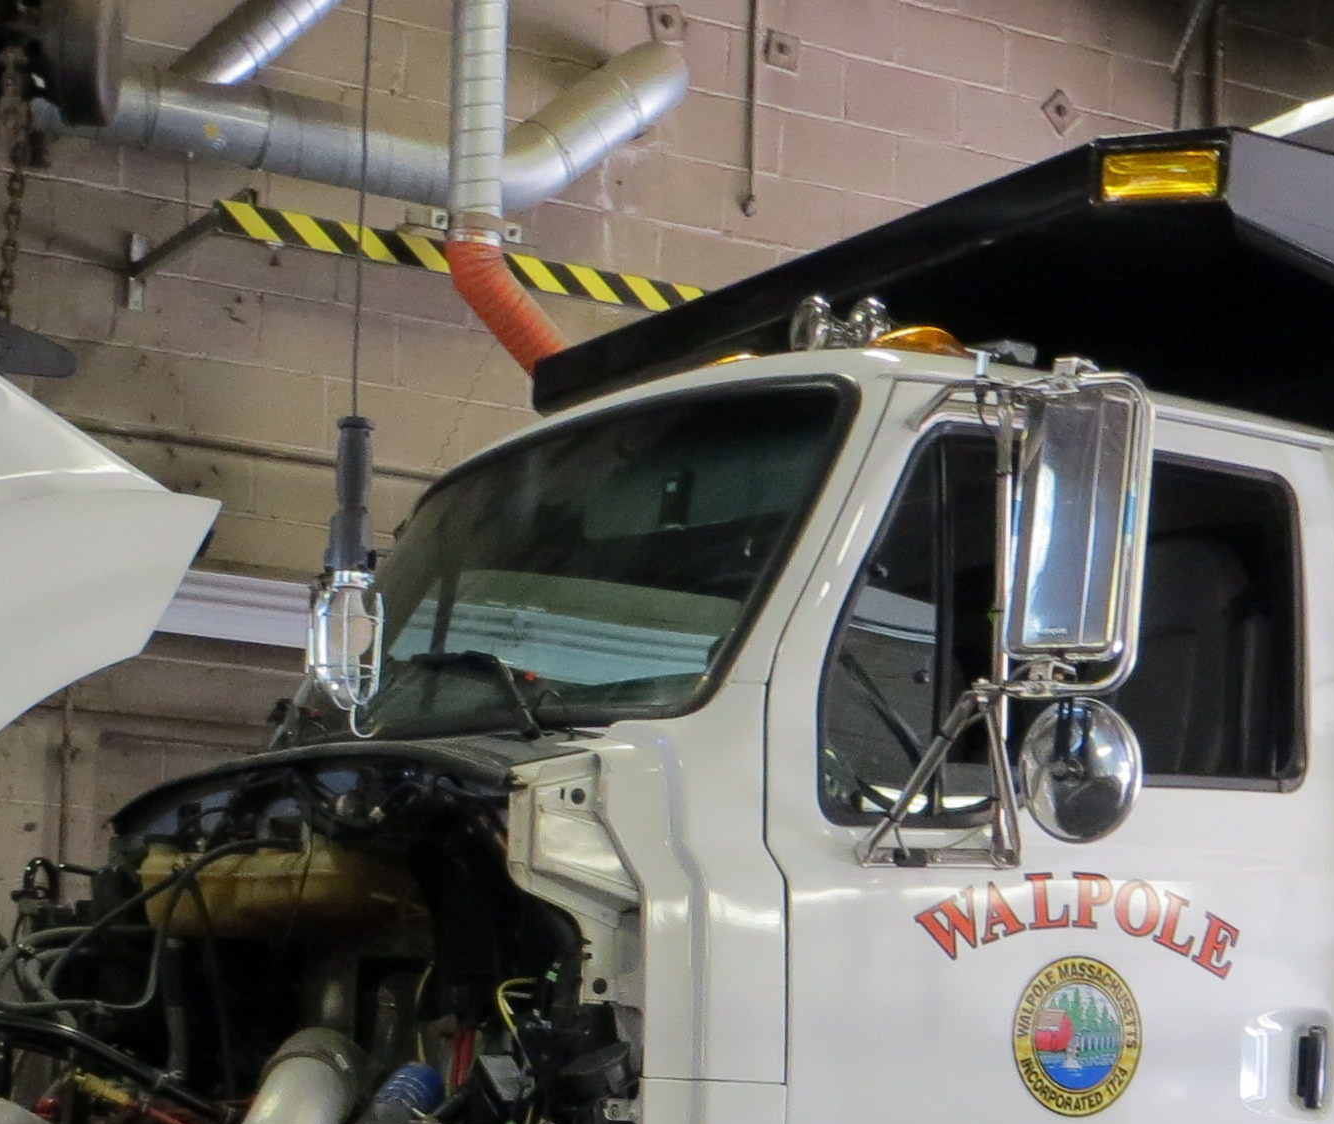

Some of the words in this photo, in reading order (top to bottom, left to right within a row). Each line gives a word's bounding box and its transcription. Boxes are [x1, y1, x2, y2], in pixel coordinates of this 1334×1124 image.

[914, 871, 1241, 981] WALPOLE
[1016, 969, 1058, 1038] WALPOLE
[1057, 961, 1139, 1050] MASSACHUSETTS
[1019, 1057, 1104, 1112] INCORPORATED
[1105, 1065, 1130, 1096] 1724
